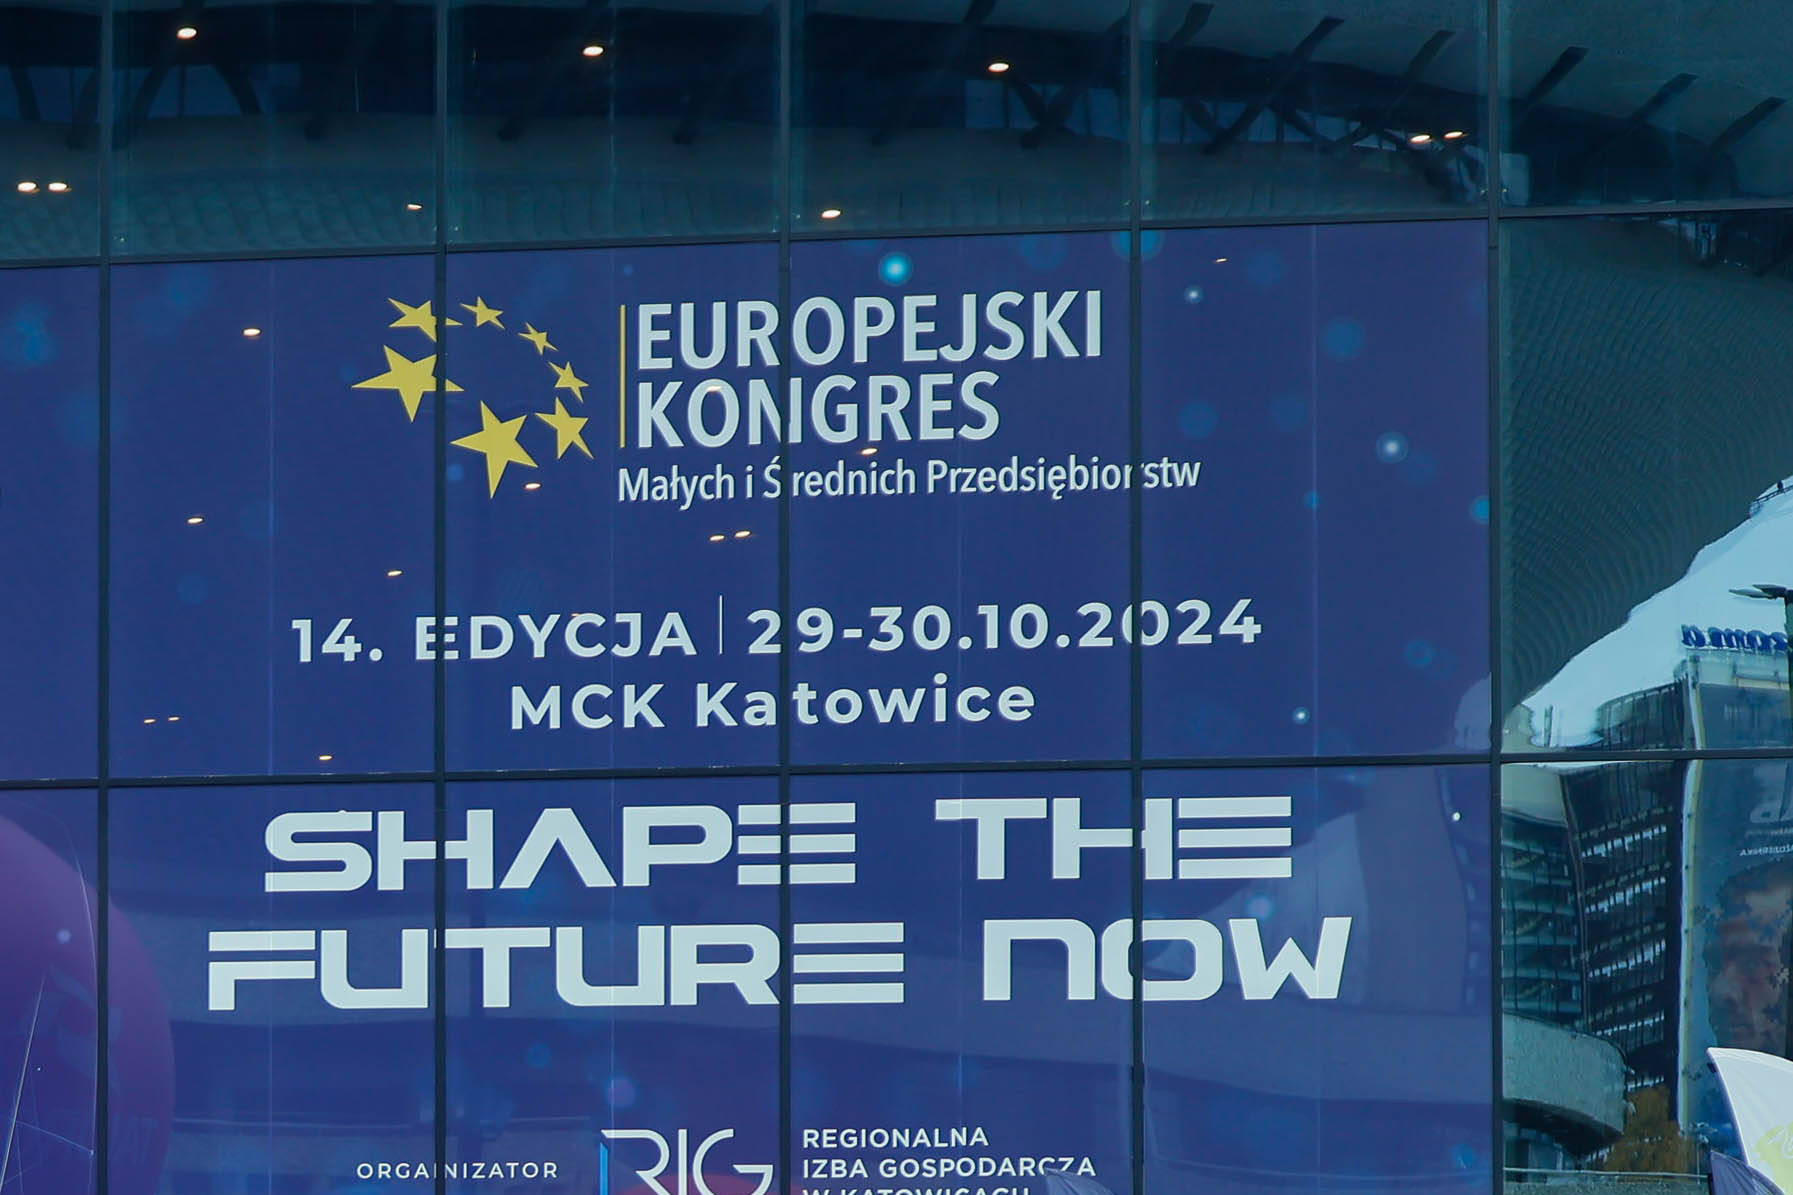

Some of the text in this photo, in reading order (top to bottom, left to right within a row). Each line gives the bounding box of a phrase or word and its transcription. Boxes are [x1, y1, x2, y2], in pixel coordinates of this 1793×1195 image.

[637, 289, 1101, 371] EUROPEJSKI
[637, 370, 1000, 450] KONGRES
[618, 453, 1201, 511] Małych i Średnich Przedsiębiorstw
[291, 598, 1263, 663] 14. EDYCJA 29-30.10.2024
[510, 672, 1036, 730] MCK Katowice
[264, 795, 1293, 892] SHAPE THE
[208, 916, 1353, 1011] FUTURE NOW
[802, 1126, 990, 1150] REGIONALNA
[802, 1155, 1097, 1179] IZBA GOSPODARCZA
[355, 1162, 558, 1179] ORGANIZATOR
